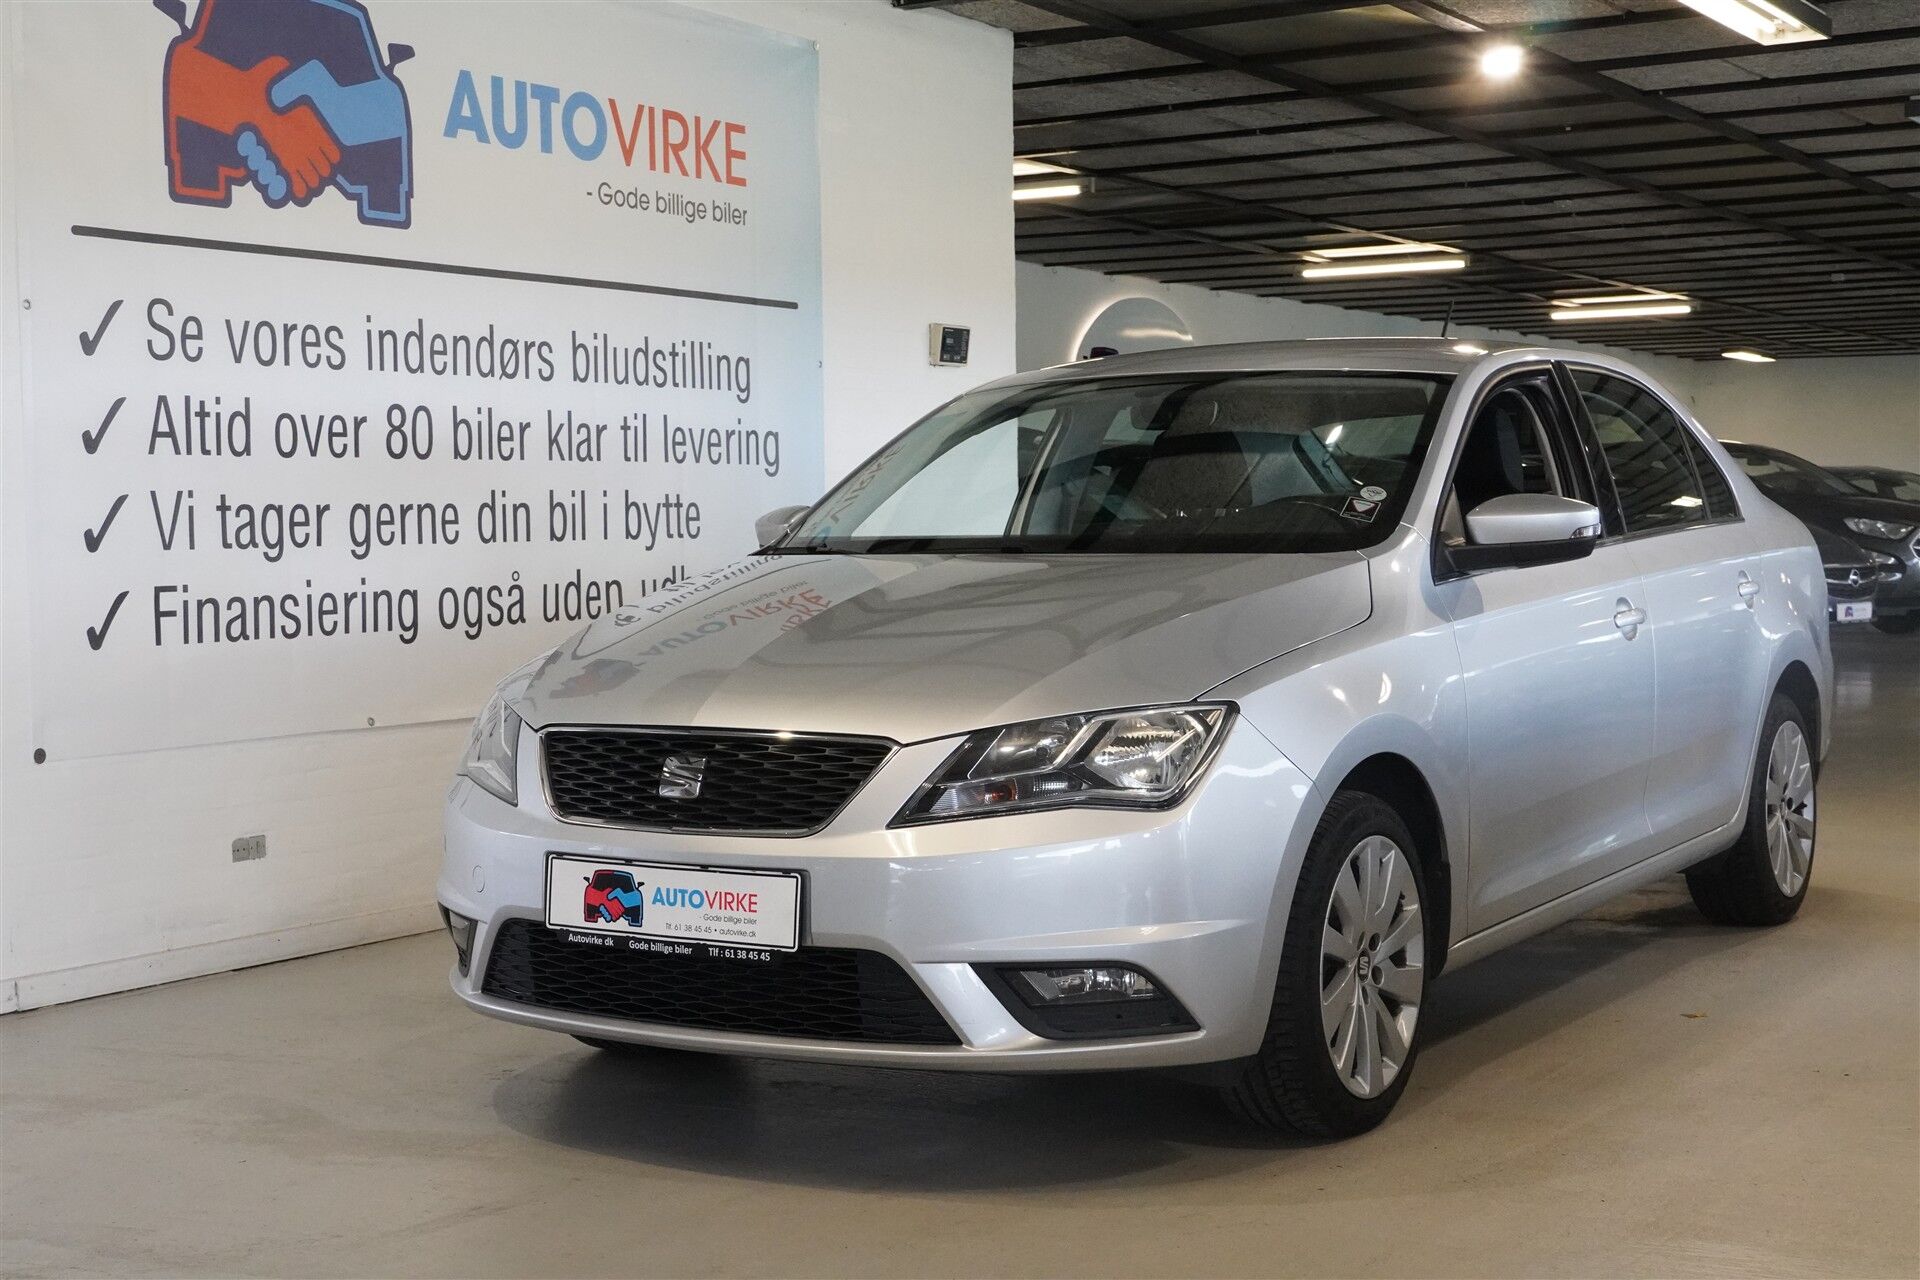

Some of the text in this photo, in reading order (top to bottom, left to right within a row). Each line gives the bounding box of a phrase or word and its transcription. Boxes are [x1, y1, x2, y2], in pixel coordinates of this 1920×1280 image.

[444, 69, 747, 187] AUTOVIRKE
[597, 182, 650, 210] Gode
[655, 190, 707, 223] billige
[712, 199, 748, 227] biler
[146, 297, 751, 404] Se vores indendørs biludstilling
[147, 394, 781, 478] Altid over 80 biler klar til levering
[149, 489, 701, 563] Vi tager gerne din bil i bytte
[153, 579, 419, 647] Finansiering
[438, 570, 527, 641] også
[542, 568, 624, 623] uden
[651, 886, 758, 913] AUTOVIRKE
[674, 923, 682, 931] 61
[684, 924, 693, 932] 38
[694, 925, 702, 933] 45
[703, 913, 722, 922] Gode
[723, 915, 742, 925] billige
[743, 917, 757, 925] biler
[568, 933, 603, 945] Autovirke
[604, 937, 614, 946] dk
[628, 940, 649, 951] Gode
[650, 942, 673, 954] billige
[674, 945, 692, 955] biler
[708, 947, 719, 957] Tlf
[724, 949, 735, 958] 61
[737, 950, 747, 959] 38
[748, 951, 759, 960] 45
[760, 952, 771, 961] 45
